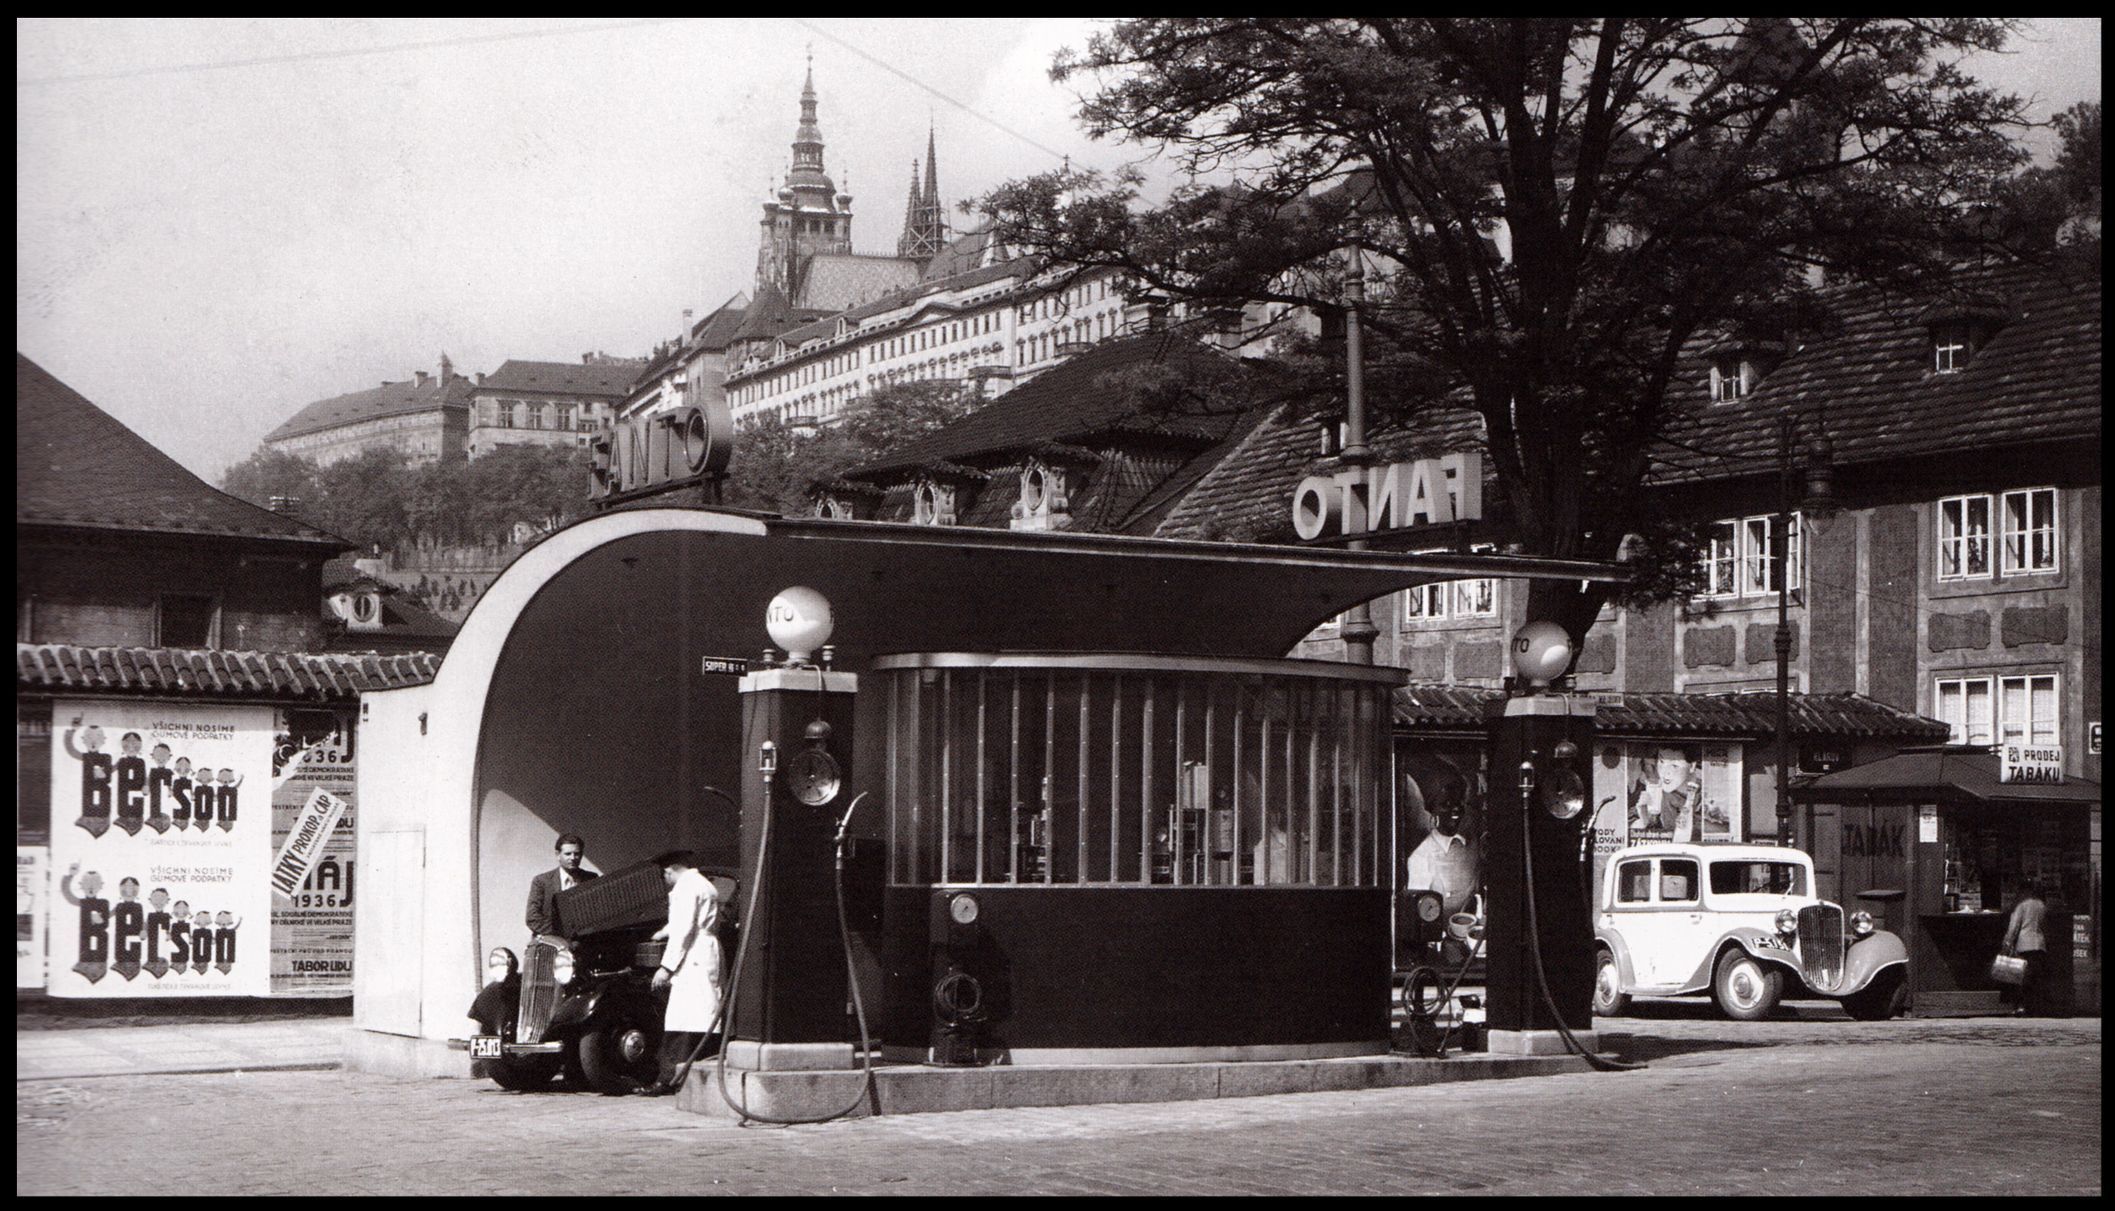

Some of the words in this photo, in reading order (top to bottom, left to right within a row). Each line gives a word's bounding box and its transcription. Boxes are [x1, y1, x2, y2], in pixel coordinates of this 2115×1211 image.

[152, 721, 192, 731] VŠICHNI
[2024, 749, 2060, 762] PRODEJ
[2008, 762, 2060, 781] TABÁKU
[292, 815, 321, 855] PROKOP
[293, 894, 337, 908] 1936
